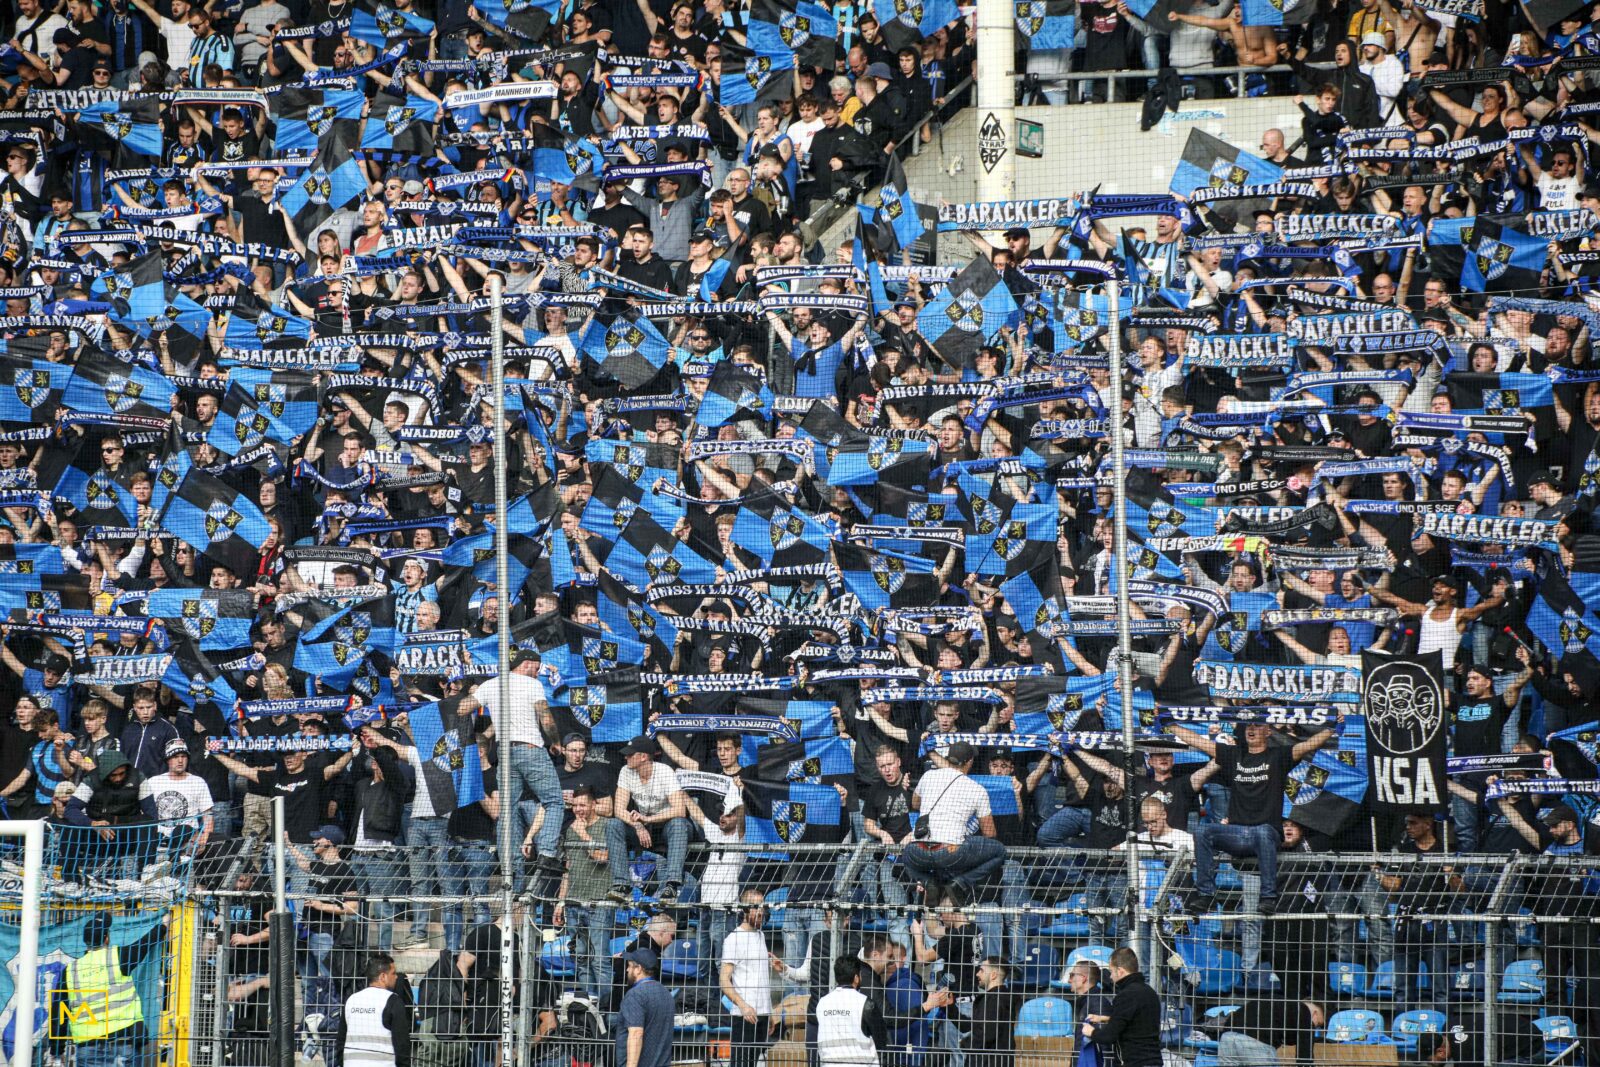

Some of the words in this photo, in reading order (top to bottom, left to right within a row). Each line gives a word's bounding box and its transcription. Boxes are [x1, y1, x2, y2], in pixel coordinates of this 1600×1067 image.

[453, 95, 462, 103] SV
[463, 91, 493, 102] WALDHOF
[495, 87, 532, 98] MANNHEIM
[533, 87, 543, 95] 07
[956, 199, 1060, 224] BARACKLER
[1187, 336, 1293, 360] BARACKLE
[400, 428, 462, 440] WALDHOF
[1212, 483, 1236, 494] UND
[1240, 481, 1258, 491] DIE
[1351, 503, 1394, 512] WALDHOF
[1395, 503, 1416, 513] UND
[1417, 504, 1432, 513] DIE
[1434, 504, 1455, 513] SGE
[1425, 514, 1545, 542] BARACKLER
[48, 617, 145, 631] WALDHOF-POWER
[1214, 668, 1335, 694] BARACKLER
[247, 699, 345, 713] WALDHOF-POWER
[653, 719, 705, 729] WALDHOF
[719, 719, 780, 730] MANNHEIM
[228, 739, 275, 752] WALDHOF
[278, 739, 329, 752] MANNHEIM
[1373, 755, 1441, 805] KSA
[350, 1007, 376, 1015] ORDNER
[823, 1009, 851, 1018] ORDNER
